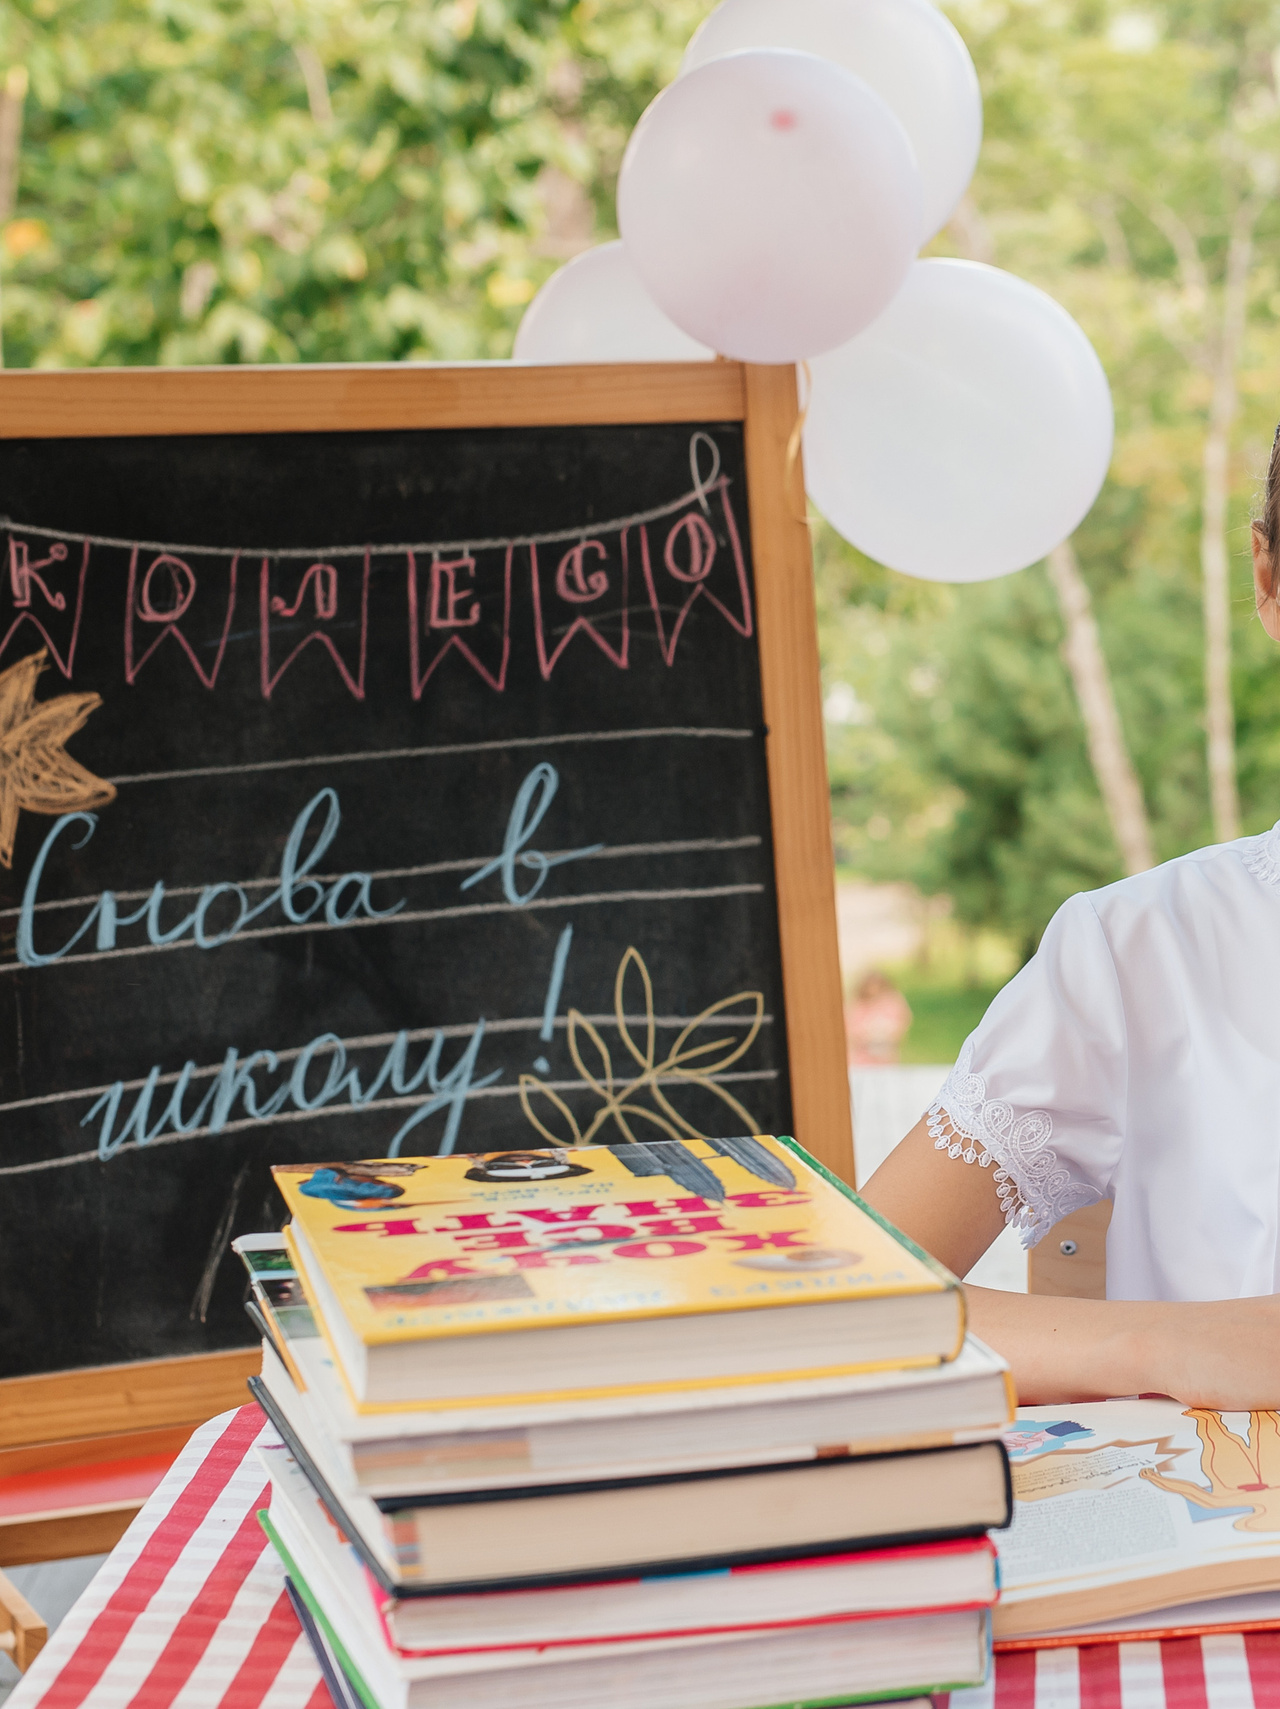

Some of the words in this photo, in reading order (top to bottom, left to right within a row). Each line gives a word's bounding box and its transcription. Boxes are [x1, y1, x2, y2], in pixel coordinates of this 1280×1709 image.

[16, 786, 405, 967] Снова
[460, 761, 605, 907] в
[332, 1188, 814, 1237] ЗНАТЬ
[400, 1228, 809, 1281] ХОЧУ
